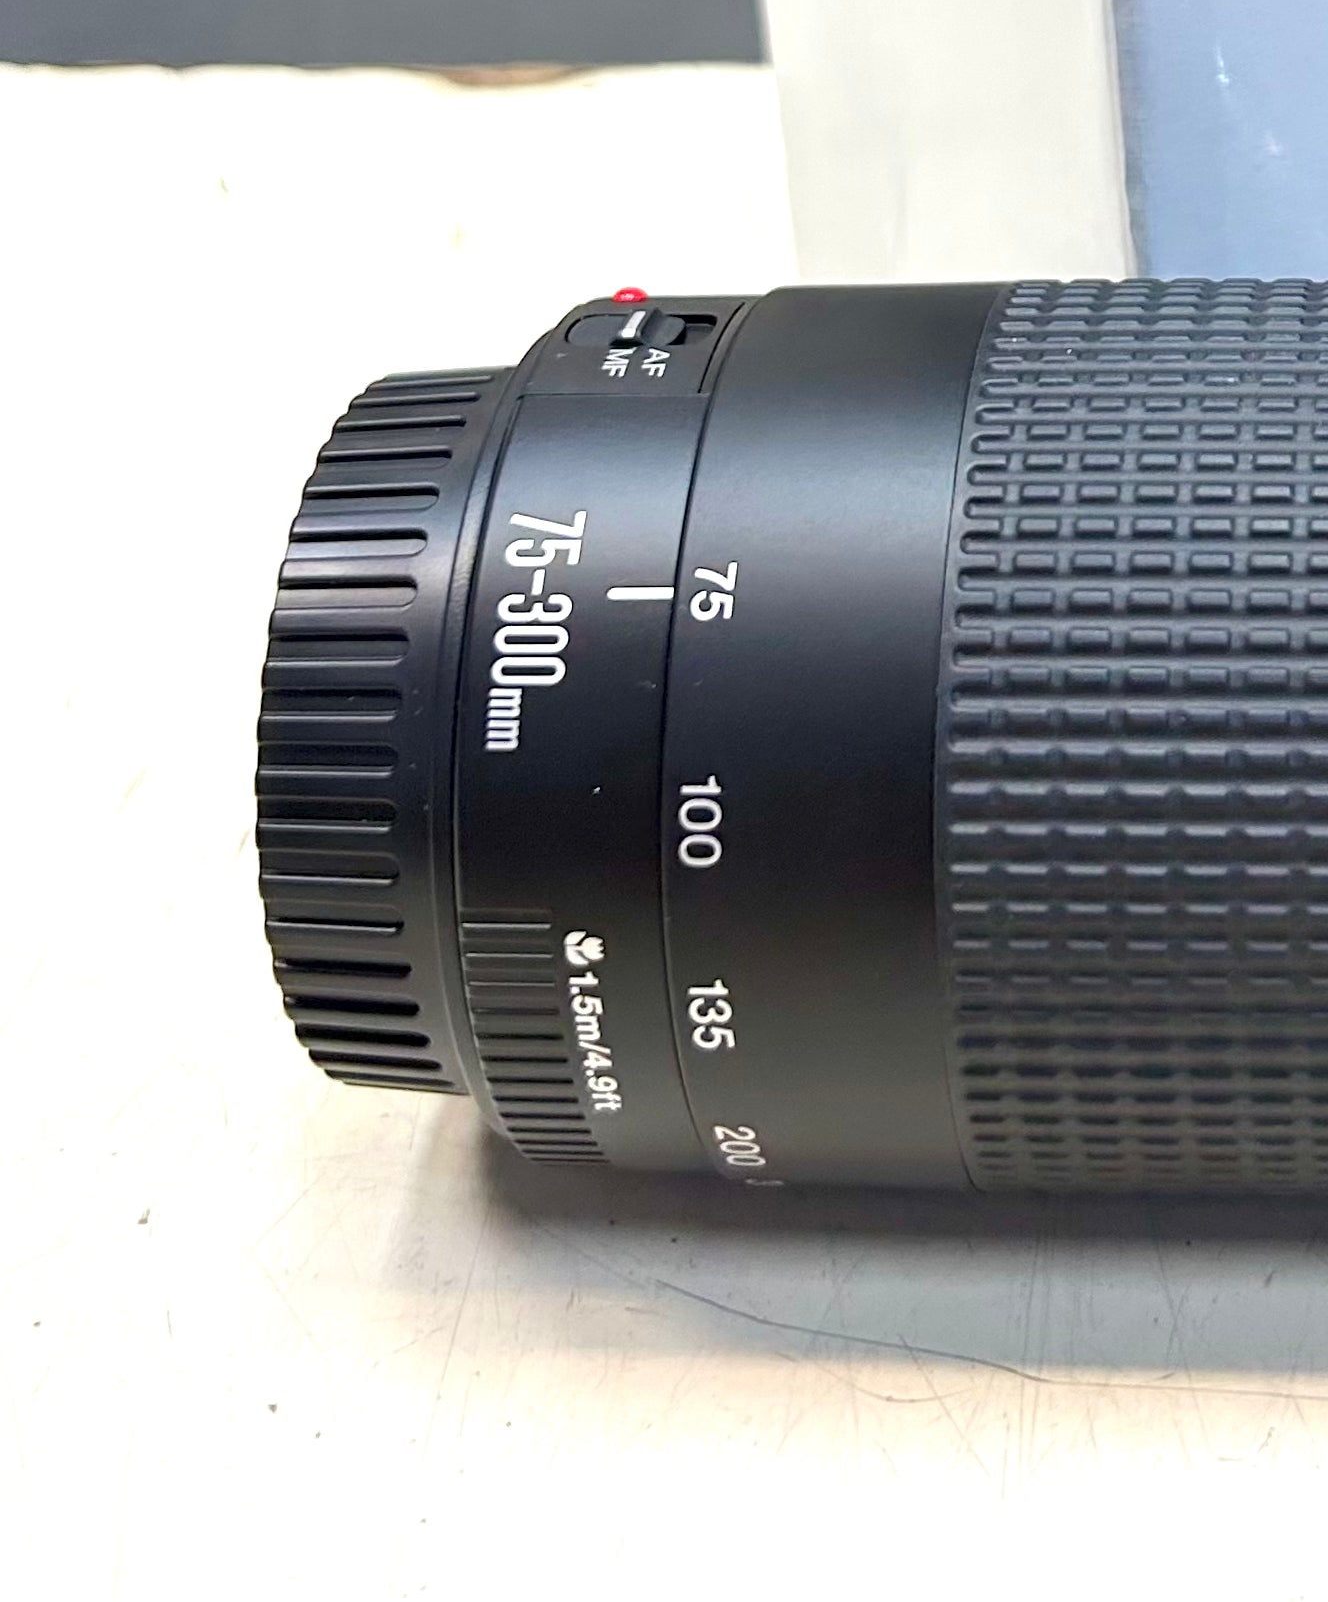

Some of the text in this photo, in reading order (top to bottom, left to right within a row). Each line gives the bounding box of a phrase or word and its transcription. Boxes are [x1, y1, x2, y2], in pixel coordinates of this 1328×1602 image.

[602, 347, 637, 379] MF
[641, 347, 671, 378] AF
[688, 560, 739, 622] 75
[484, 509, 588, 752] 75-300mm
[677, 774, 723, 869] 100
[567, 971, 623, 1112] 1.5m/4.9ft
[686, 978, 737, 1050] 135
[713, 1125, 767, 1167] 200
